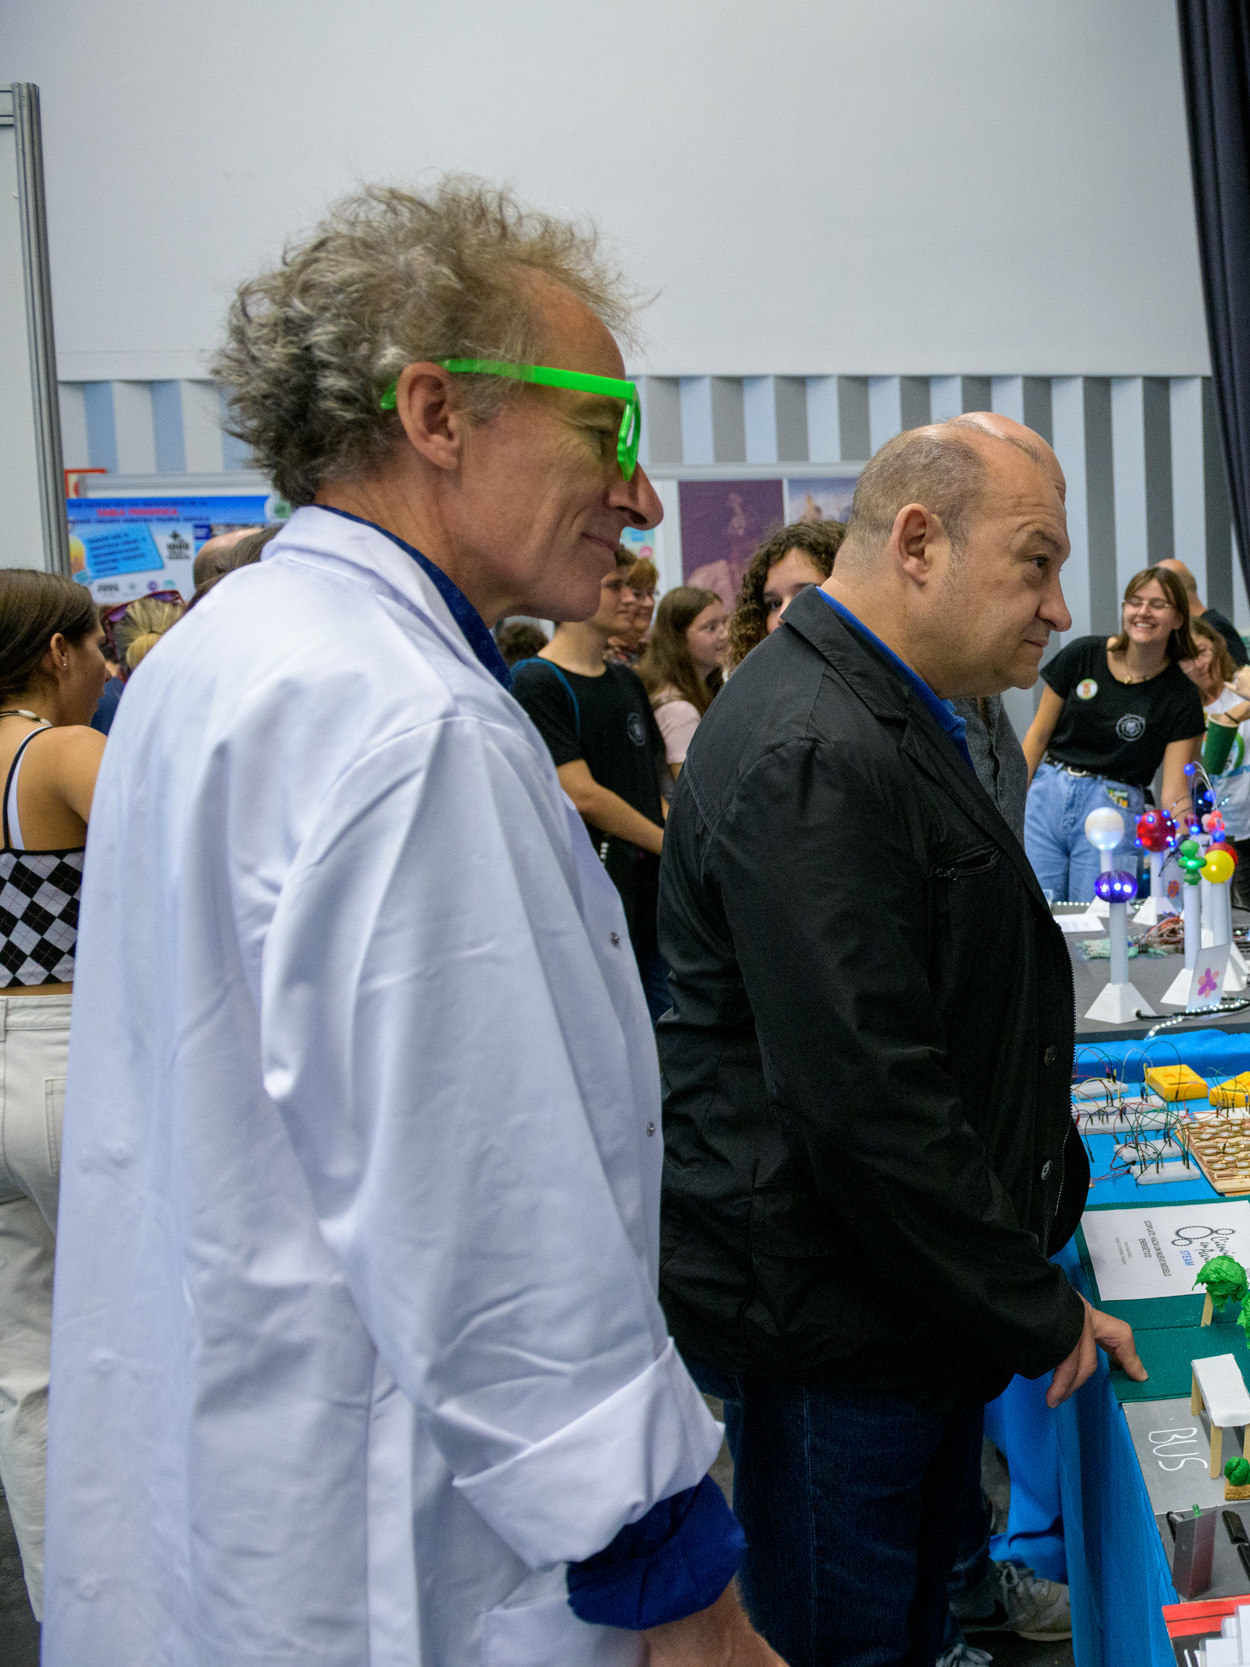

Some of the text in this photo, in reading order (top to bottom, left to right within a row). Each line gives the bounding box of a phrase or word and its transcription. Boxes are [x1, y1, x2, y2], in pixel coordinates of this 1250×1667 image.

[1143, 1220, 1156, 1236] ECOPLATE
[1149, 1236, 1159, 1247] HACIA
[1155, 1251, 1166, 1263] NUEVO
[1180, 1249, 1195, 1267] STEAM
[1159, 1262, 1172, 1277] MODELO
[1148, 1427, 1208, 1472] BUS
